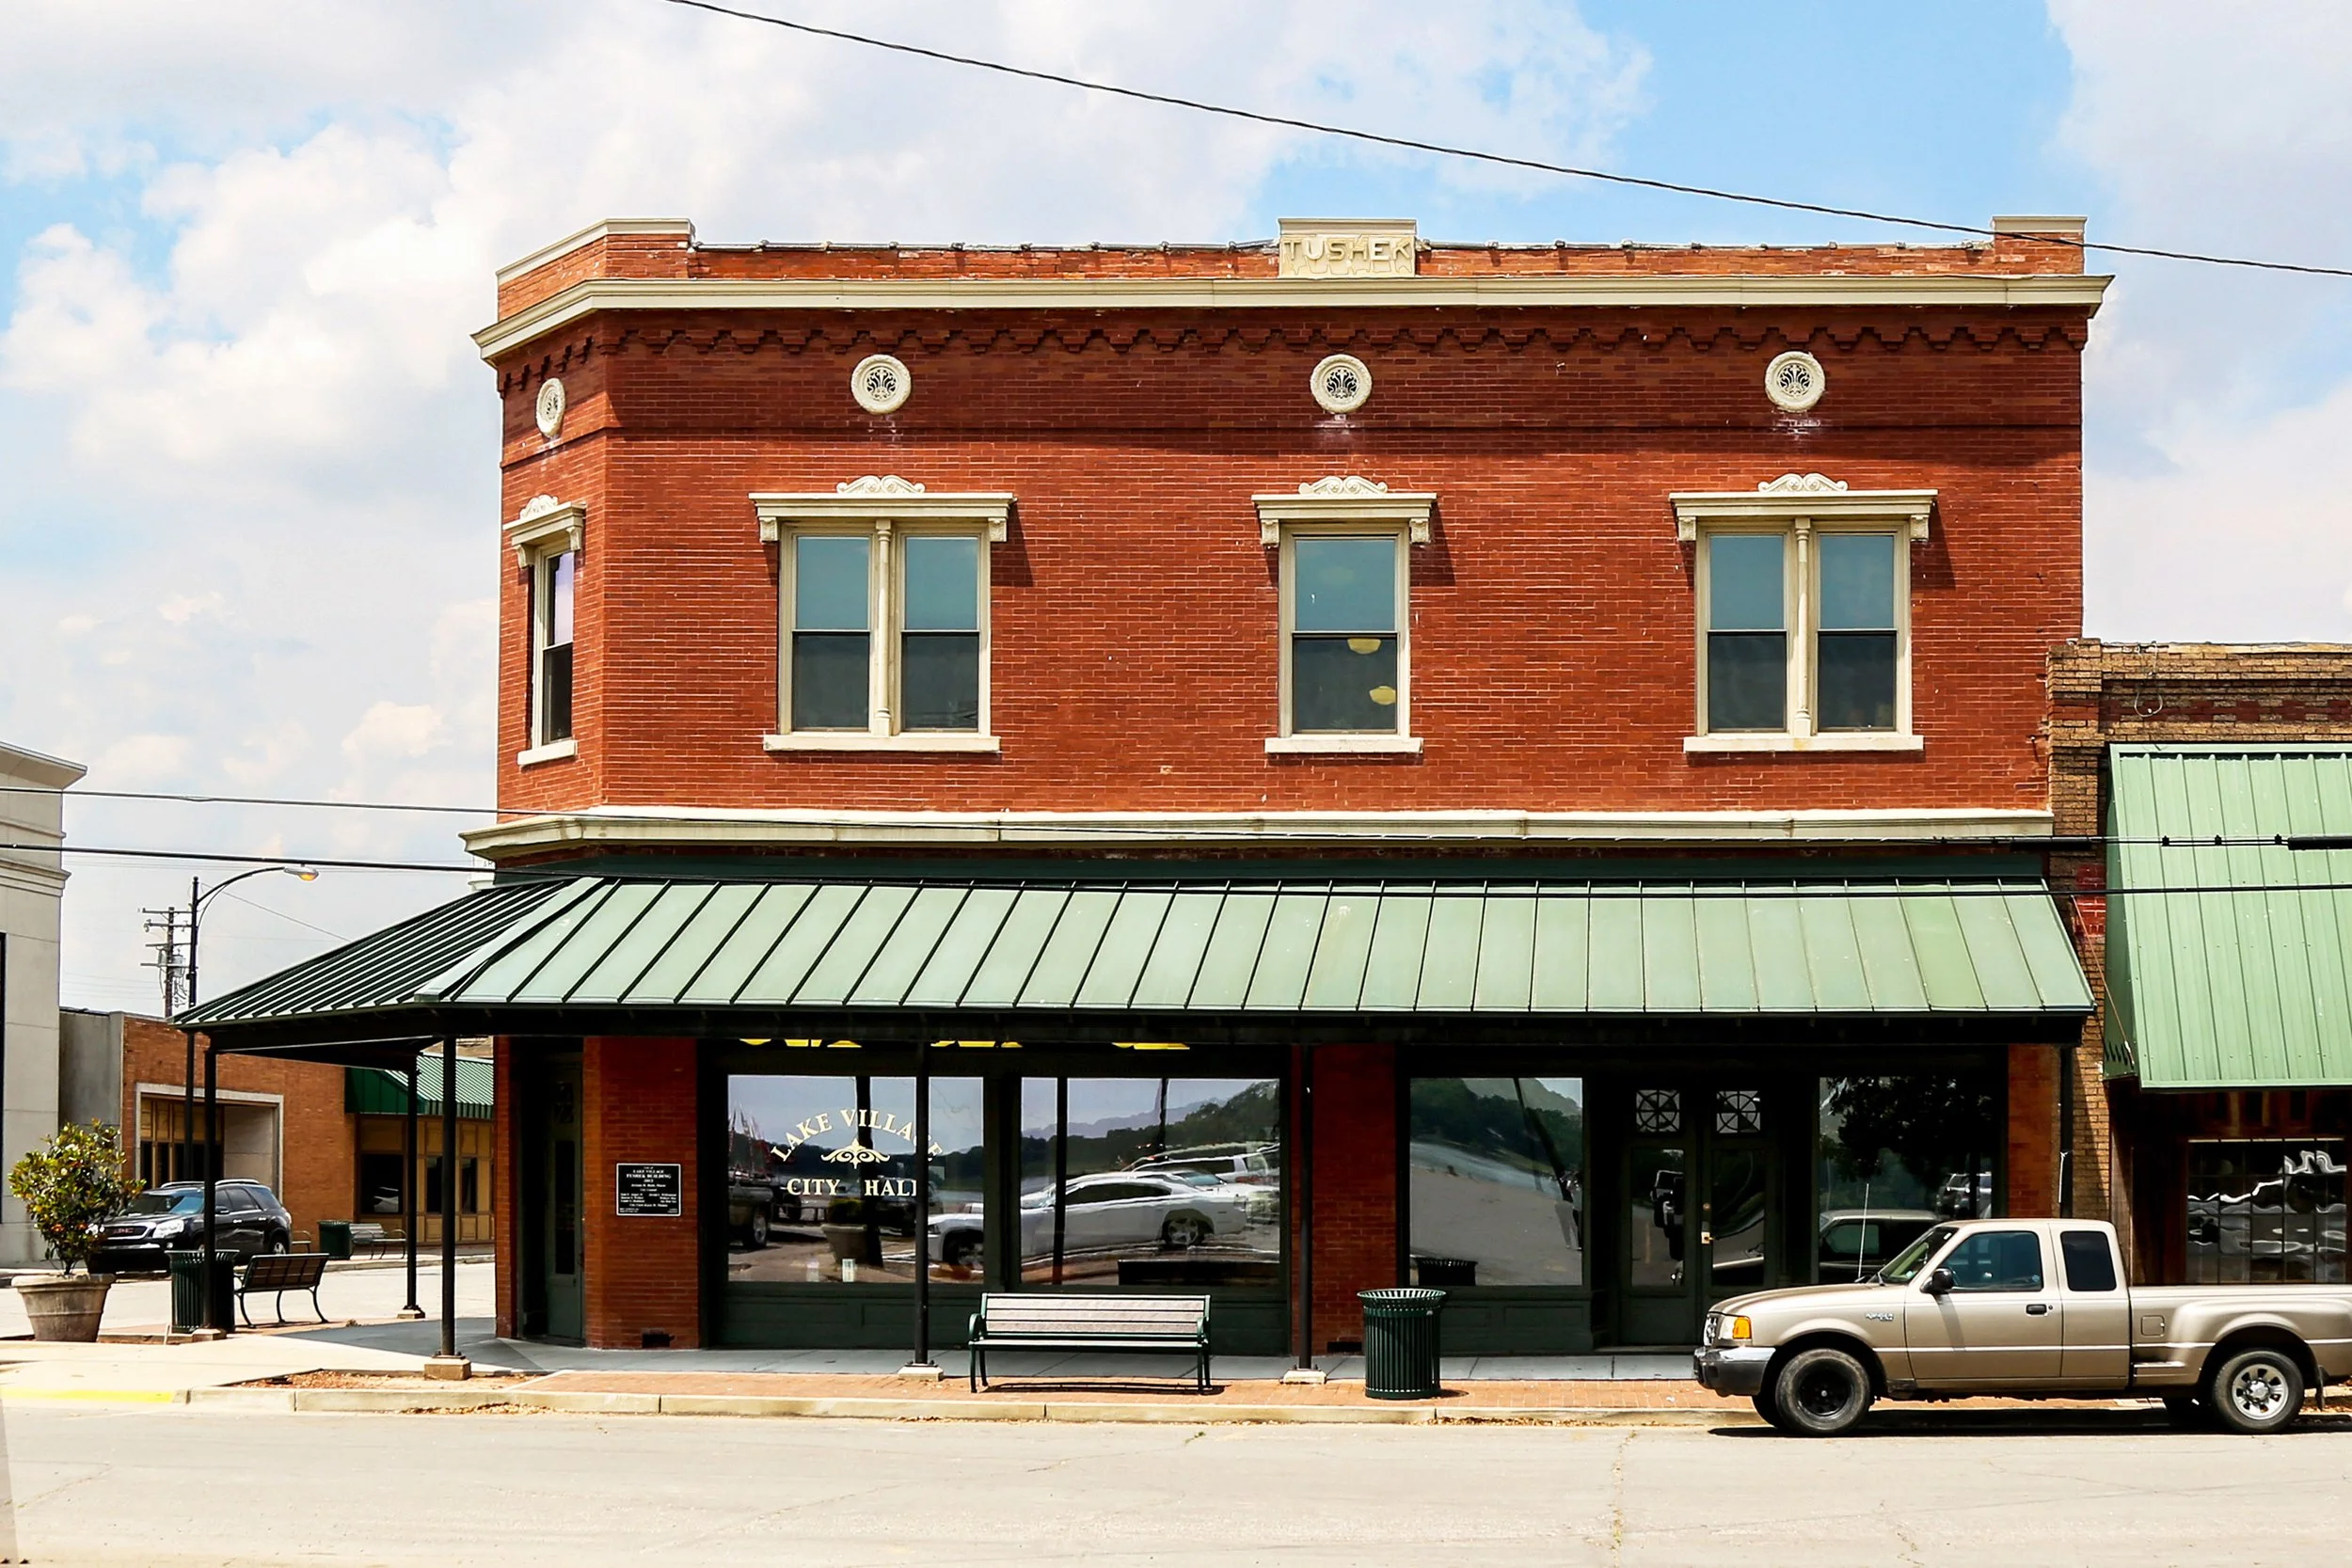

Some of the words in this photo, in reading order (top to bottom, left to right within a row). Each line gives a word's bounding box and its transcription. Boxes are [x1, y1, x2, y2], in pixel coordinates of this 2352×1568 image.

[1282, 239, 1410, 261] TUSHEK
[770, 1112, 833, 1162] LAKE
[839, 1108, 945, 1162] VILLAE
[786, 1178, 840, 1196] CITY
